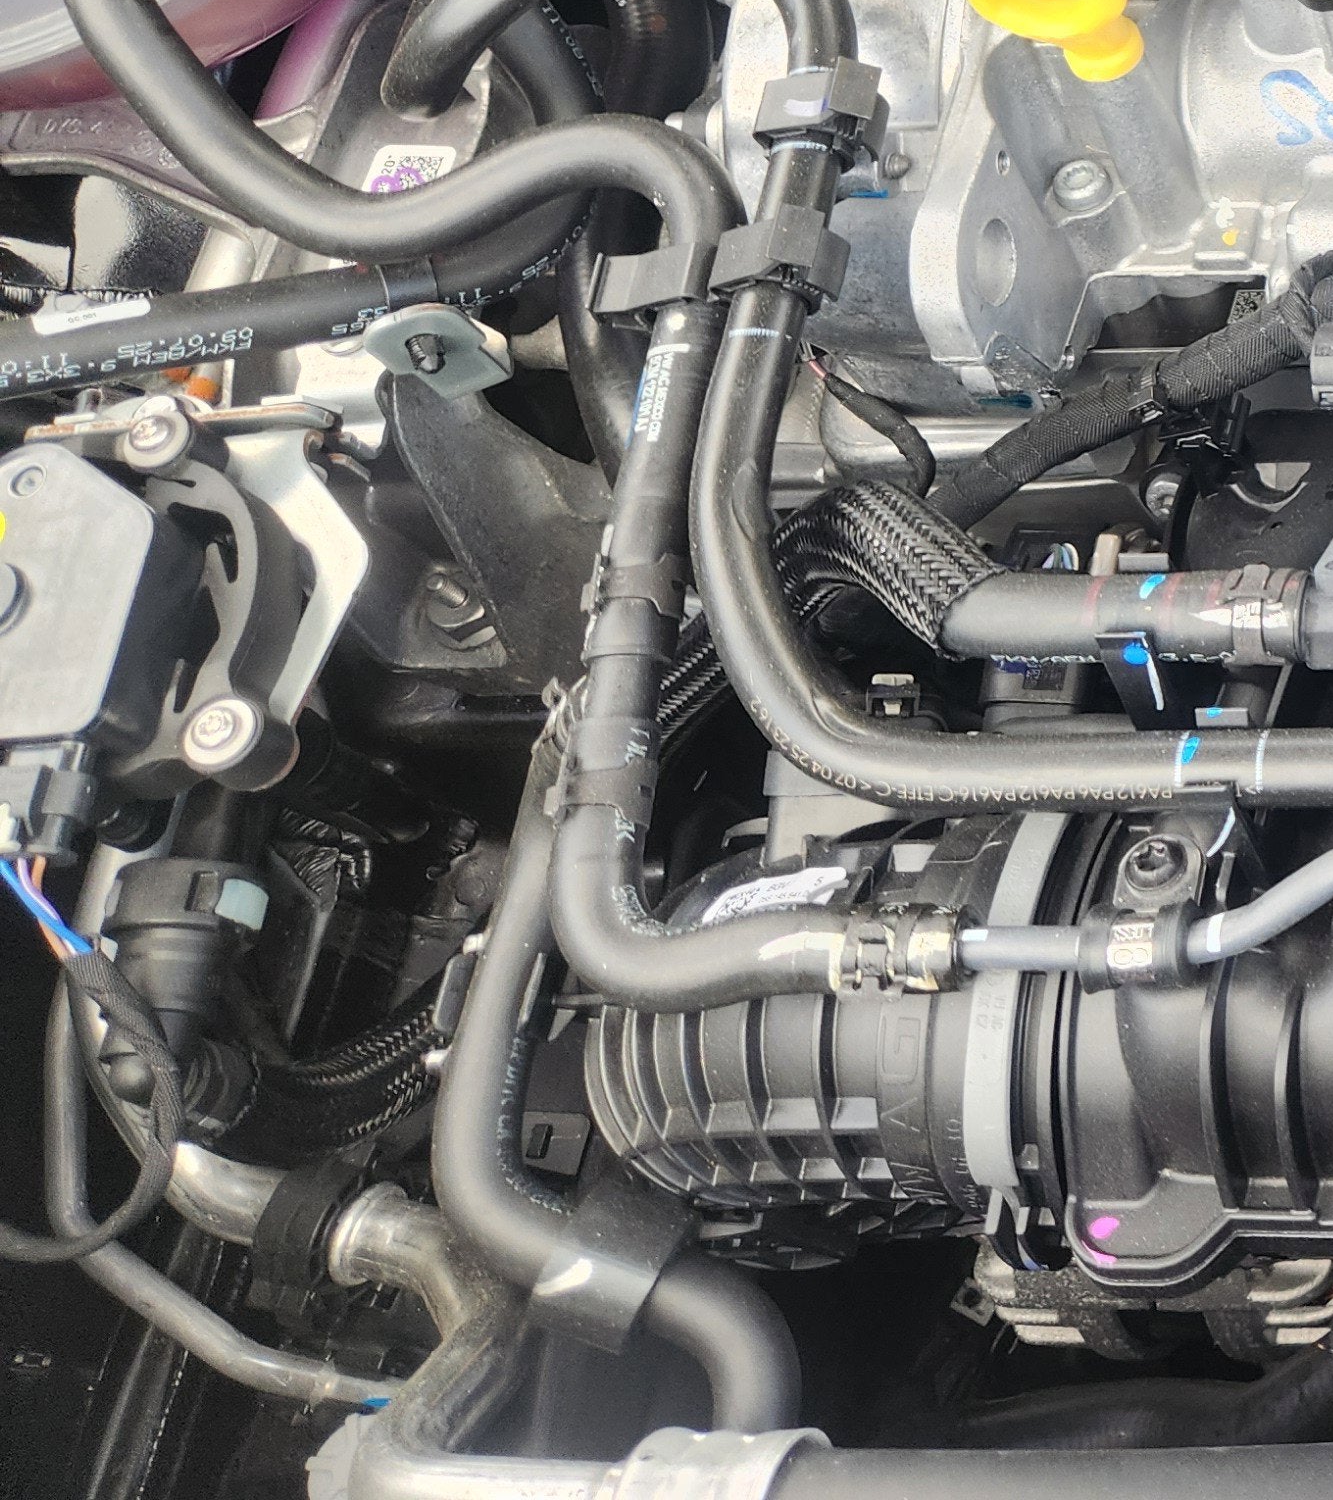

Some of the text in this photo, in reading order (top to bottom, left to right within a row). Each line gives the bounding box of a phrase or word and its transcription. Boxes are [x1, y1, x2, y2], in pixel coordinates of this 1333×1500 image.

[790, 745, 810, 767] 25
[811, 761, 833, 781] 04
[834, 774, 856, 790] 07
